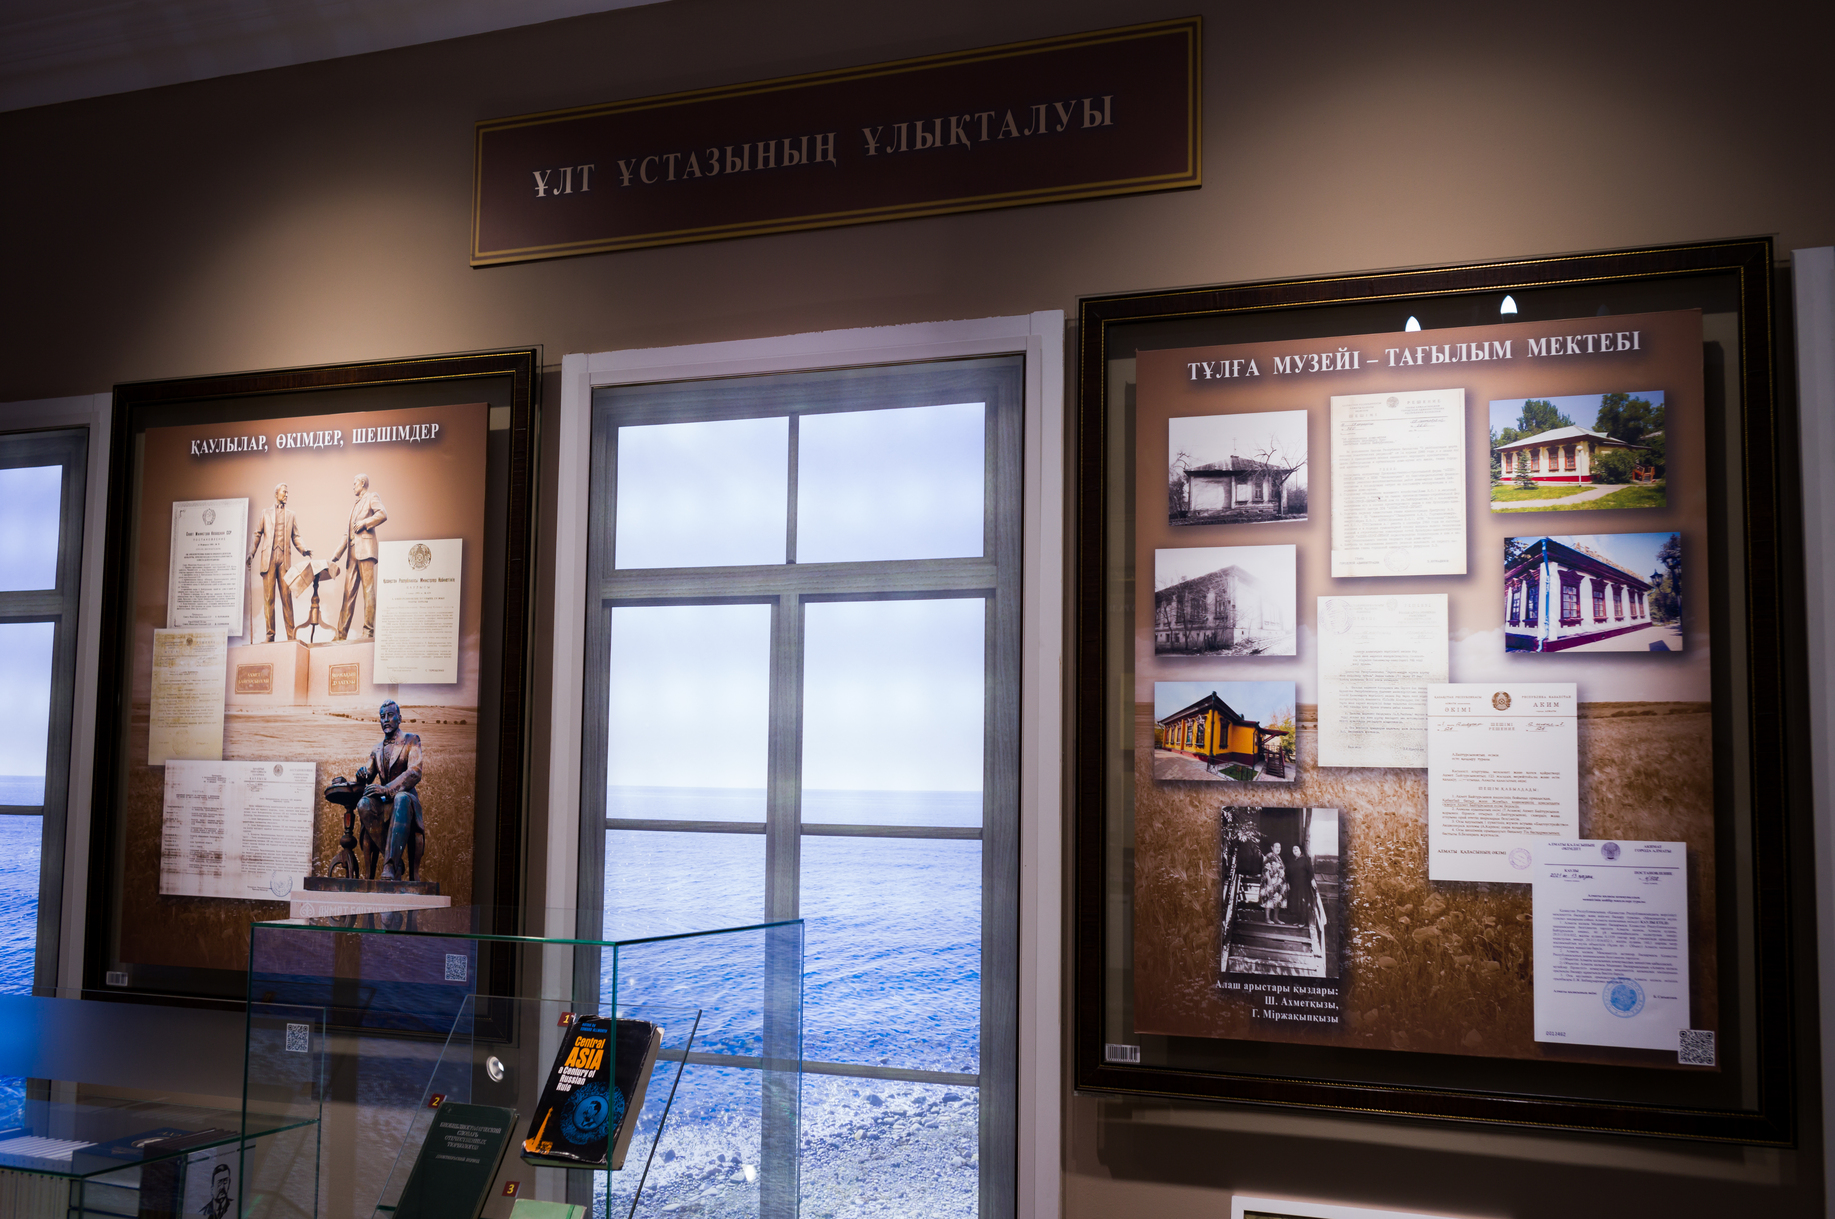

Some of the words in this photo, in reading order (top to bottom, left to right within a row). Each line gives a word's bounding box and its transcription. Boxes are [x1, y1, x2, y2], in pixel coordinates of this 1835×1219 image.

[532, 163, 595, 198] ҰЛТ
[617, 132, 837, 187] ҰСТАЗЫНЫҢ
[862, 95, 1114, 156] ҰЛЫҚТАЛУЫ
[1188, 359, 1260, 381] ТҰЛҒА
[1273, 347, 1361, 375] МУЗЕЙІ
[1385, 340, 1513, 367] ТАҒЫЛЫМ
[1527, 331, 1641, 358] МЕКТЕБІ
[190, 434, 268, 457] ҚАУЛЫЛАР,
[276, 430, 344, 450] ӨКІМДЕР,
[352, 423, 439, 444] ШЕШІМДЕР
[1215, 980, 1241, 990] Алаш
[1244, 984, 1290, 993] арыстары
[1293, 986, 1339, 996] қыздары:
[1265, 996, 1278, 1006] Ш.
[1281, 997, 1339, 1010] Ахметқызы,
[563, 1015, 570, 1023] 1
[1252, 1009, 1260, 1018] Г.
[1263, 1010, 1339, 1023] Міржақыпқызы
[575, 1036, 606, 1048] Central
[564, 1047, 604, 1070] ASIA
[558, 1066, 563, 1074] a
[563, 1066, 588, 1077] Century
[588, 1070, 596, 1078] of
[559, 1074, 586, 1086] Russian
[556, 1082, 572, 1092] Rule
[432, 1097, 440, 1106] 2
[507, 1183, 515, 1194] 3
